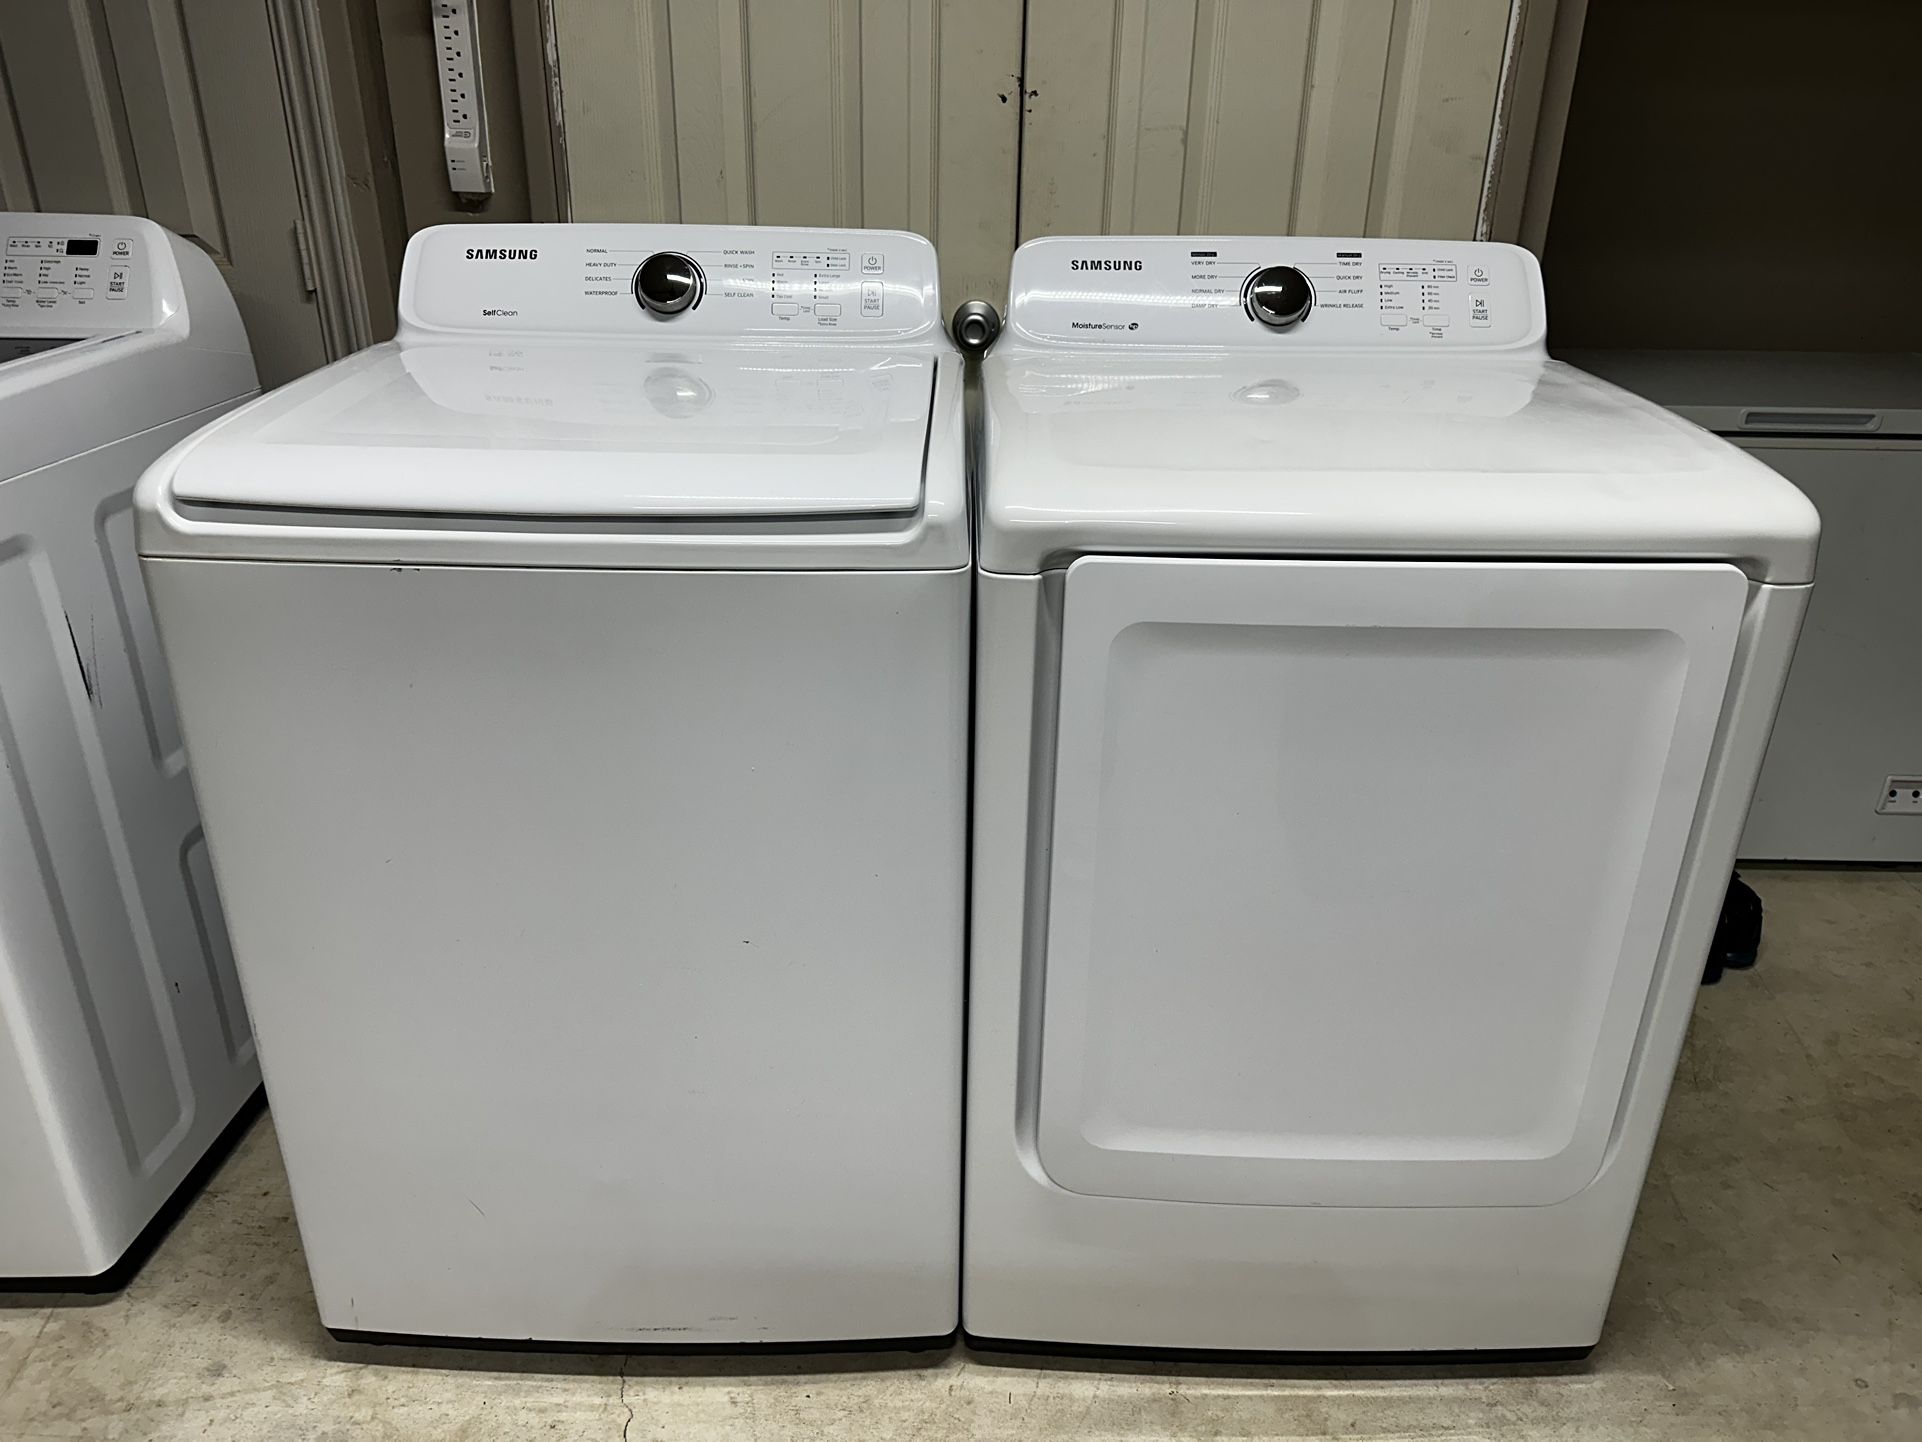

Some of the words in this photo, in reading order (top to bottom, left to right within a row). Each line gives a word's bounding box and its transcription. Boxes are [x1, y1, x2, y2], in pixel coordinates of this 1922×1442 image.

[466, 249, 538, 260] SAMSUNG
[1071, 260, 1143, 271] SAMSUNG
[482, 309, 518, 317] SelfClean
[1072, 322, 1126, 330] MoistureSensor
